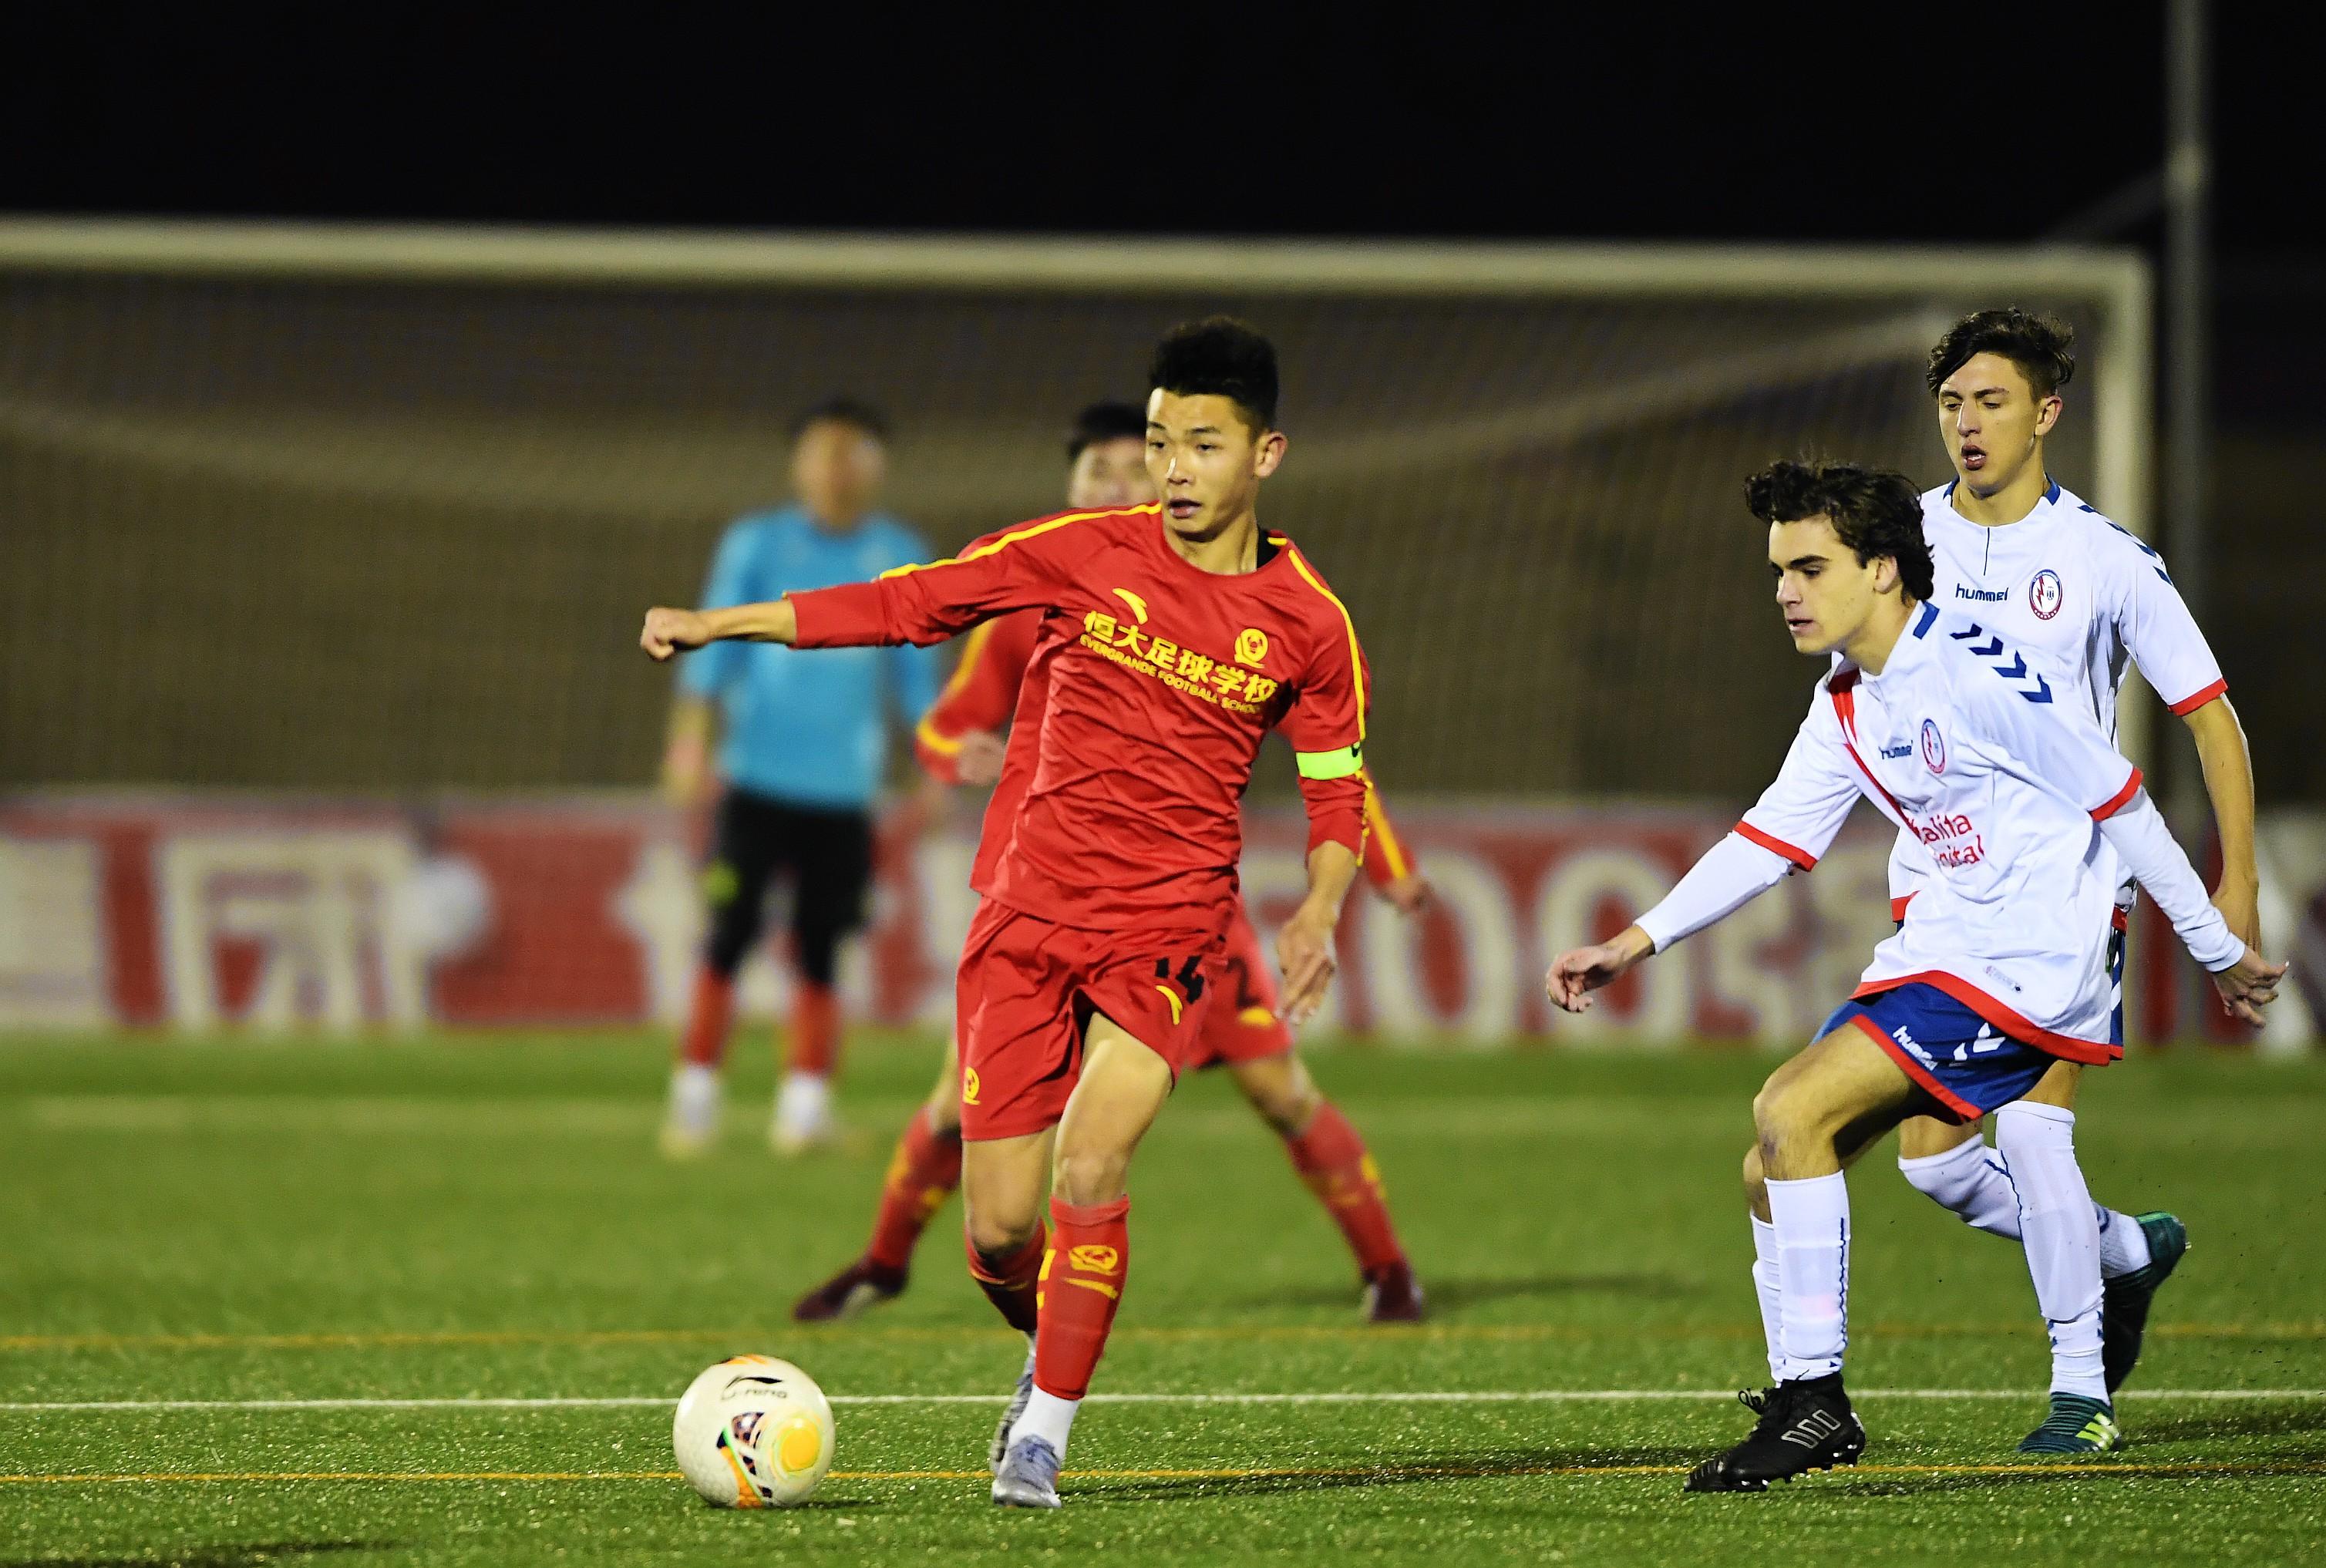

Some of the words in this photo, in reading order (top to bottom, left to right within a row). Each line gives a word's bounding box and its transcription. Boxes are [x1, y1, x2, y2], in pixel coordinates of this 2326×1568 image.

[1955, 583, 2008, 601] hummel
[1080, 634, 1156, 677] EVERGRANDE
[1157, 671, 1218, 704] FOOTBALL
[1221, 696, 1261, 714] SCHO
[1084, 611, 1277, 703] 恒大足球学校
[1921, 813, 1973, 845] alita
